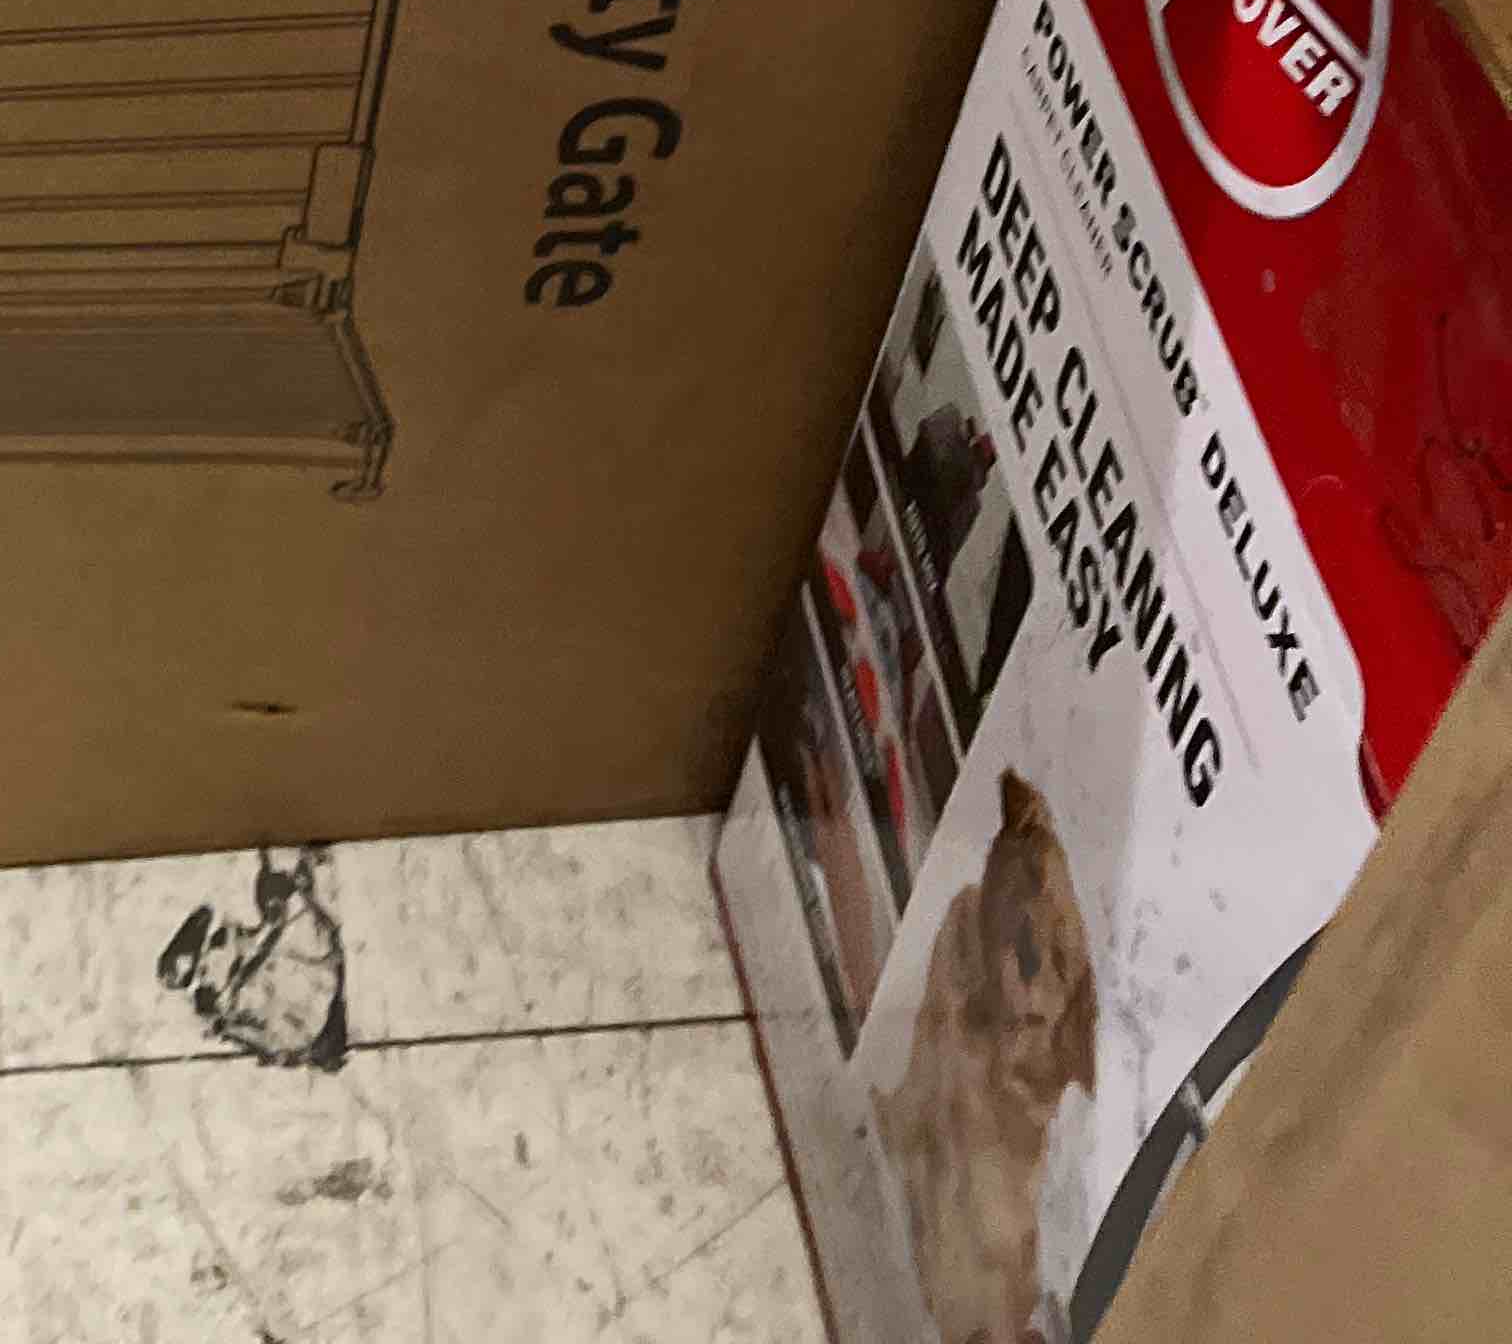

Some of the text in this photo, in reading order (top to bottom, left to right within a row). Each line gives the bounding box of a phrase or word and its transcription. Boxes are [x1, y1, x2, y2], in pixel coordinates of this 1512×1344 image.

[524, 98, 682, 308] Gate
[955, 205, 1125, 675] MADE EASY
[979, 132, 1224, 810] DEEP CLEANING
[1200, 431, 1320, 722] DELUXE
